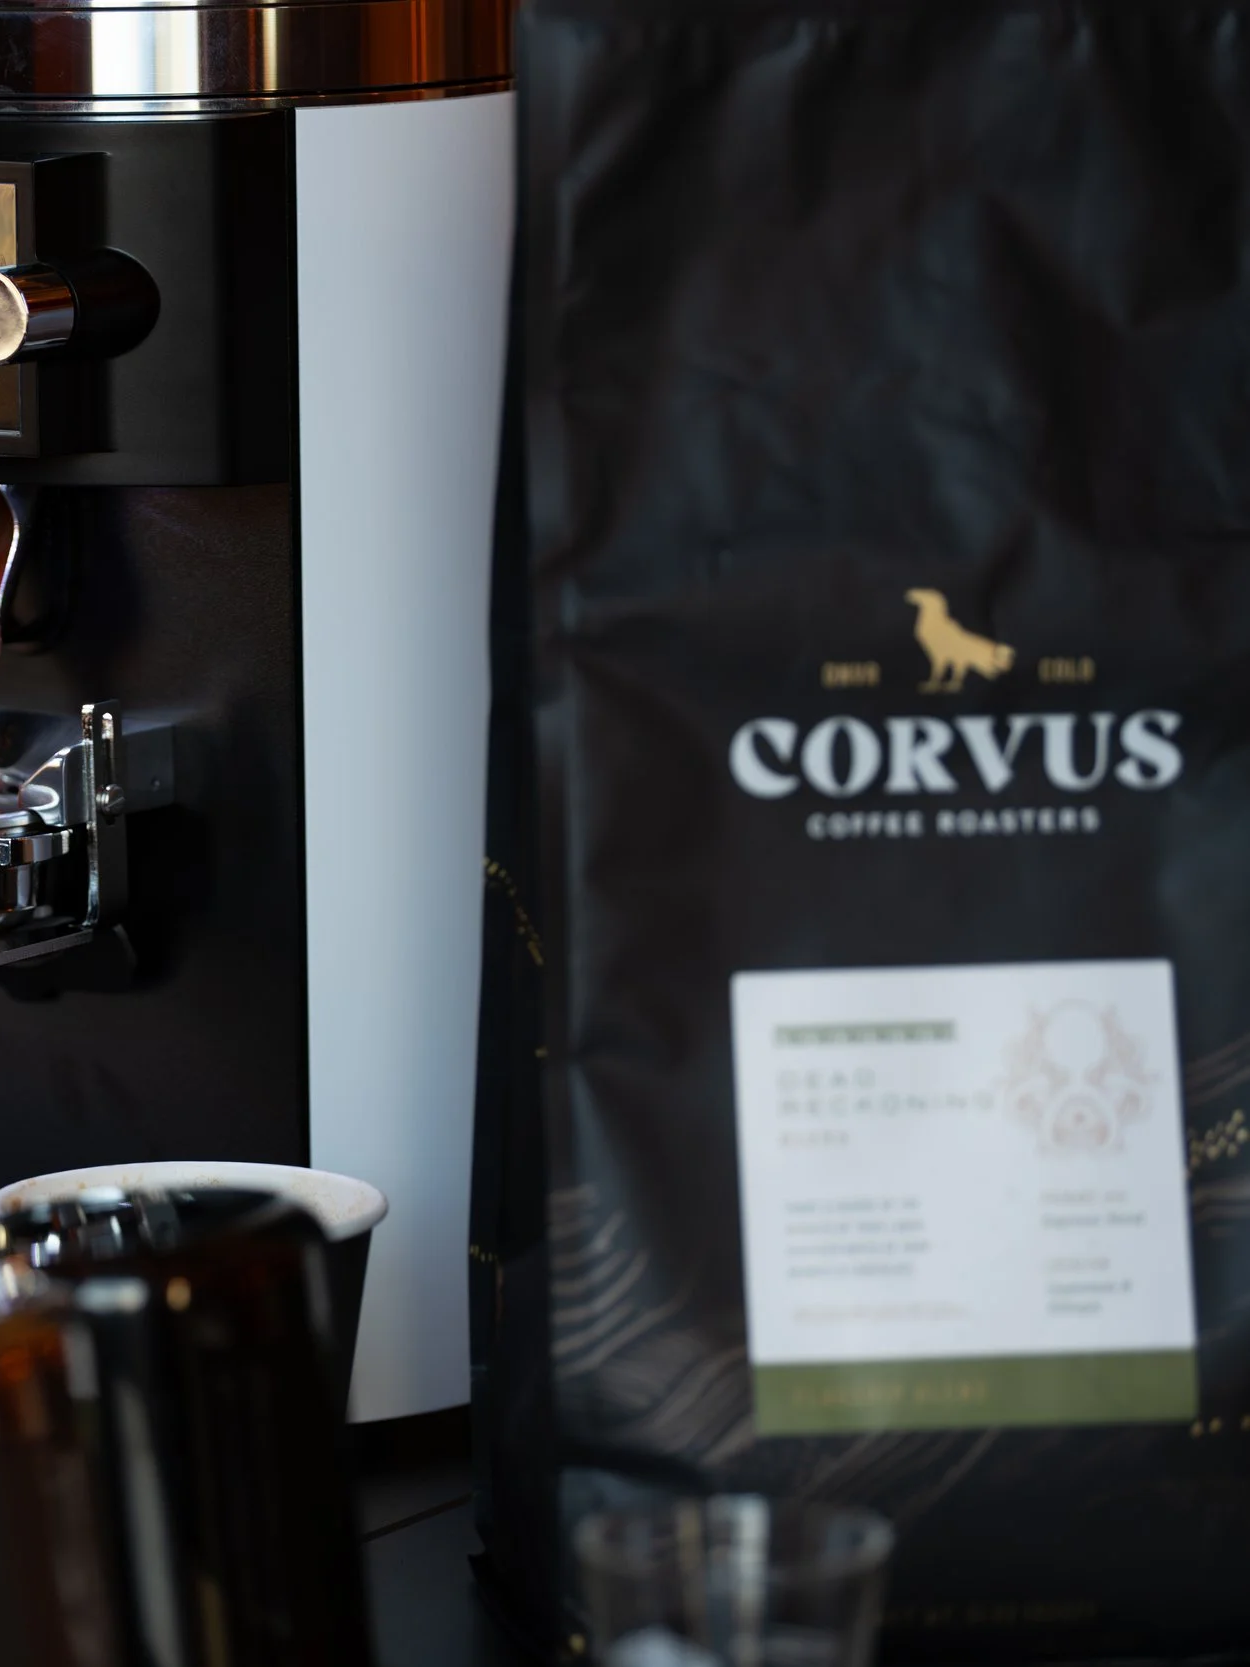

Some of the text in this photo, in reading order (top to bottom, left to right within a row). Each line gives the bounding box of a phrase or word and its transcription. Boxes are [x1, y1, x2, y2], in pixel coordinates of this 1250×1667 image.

[729, 709, 1183, 799] CORVUS
[806, 806, 1101, 840] COFFEE ROASTERS
